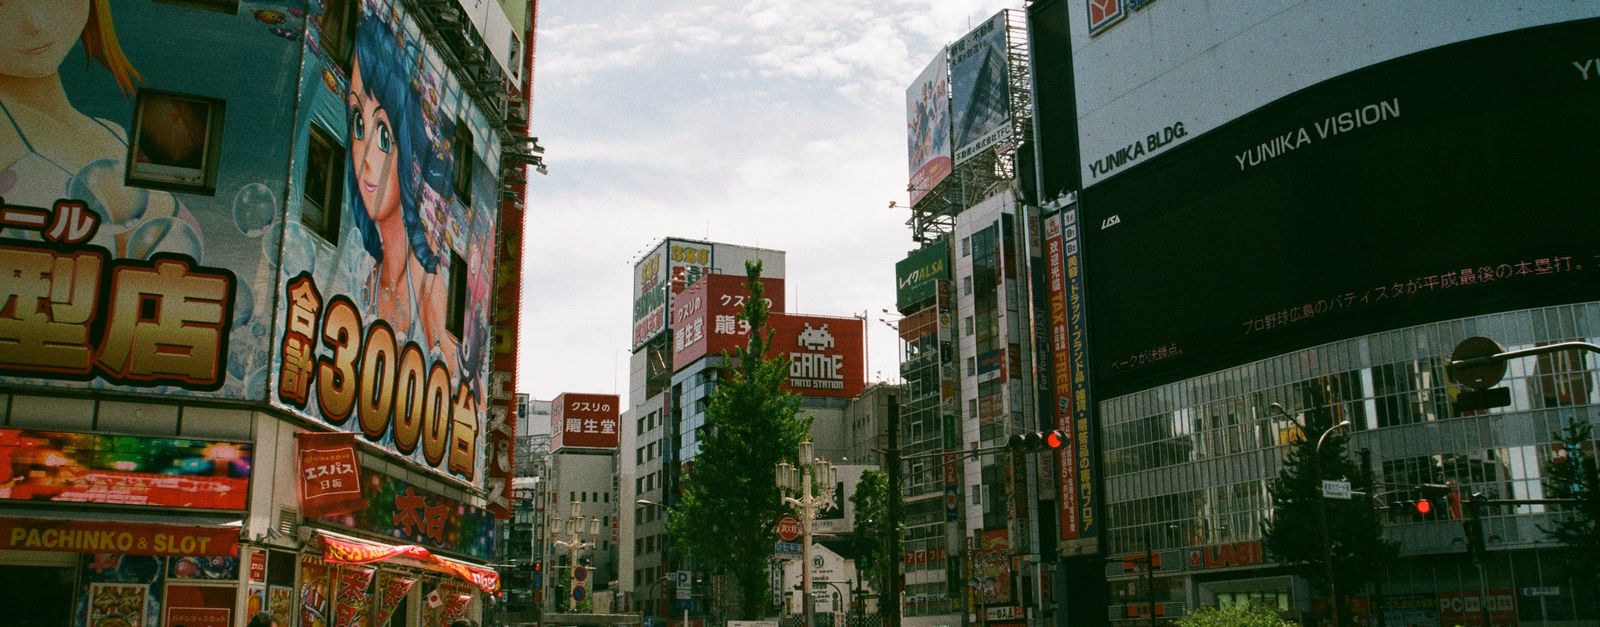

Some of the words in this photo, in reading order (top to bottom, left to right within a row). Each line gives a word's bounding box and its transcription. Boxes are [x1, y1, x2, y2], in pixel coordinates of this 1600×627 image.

[1235, 127, 1312, 171] YUNIKA
[1313, 98, 1400, 140] VISION
[1089, 140, 1145, 179] YUNIKA
[1146, 120, 1188, 153] BLDG.
[1101, 213, 1121, 230] LISA
[678, 296, 702, 323] クスリの
[675, 315, 704, 354] 龍生堂
[789, 352, 844, 380] GAME
[790, 378, 812, 388] TAITO
[813, 379, 844, 390] STATION
[571, 402, 611, 413] クスリの
[565, 417, 616, 435] 龍生堂
[305, 461, 354, 480] エスパス
[9, 527, 134, 551] PACHINKO
[137, 537, 148, 550] &
[153, 533, 212, 554] SLOT
